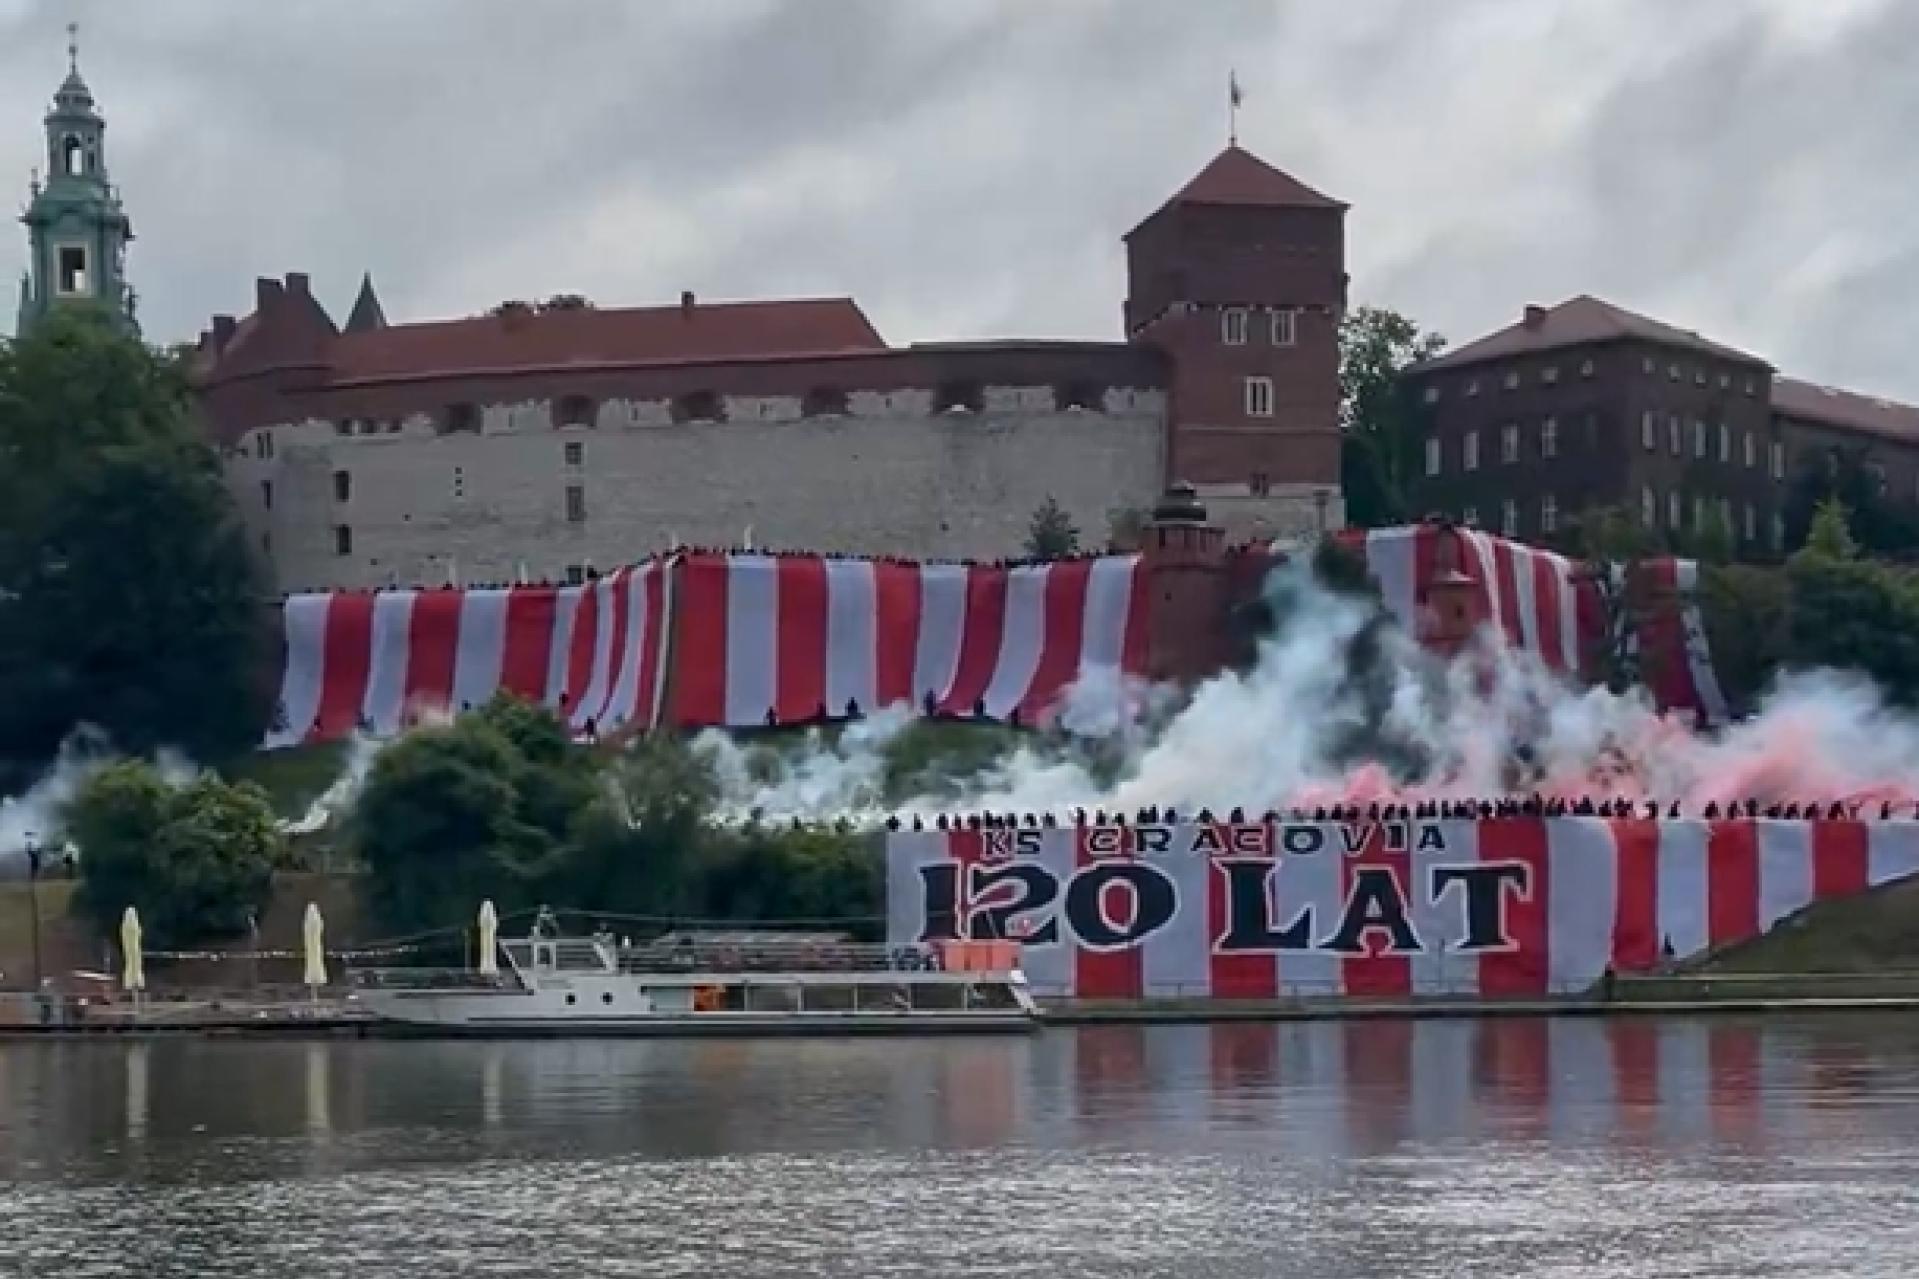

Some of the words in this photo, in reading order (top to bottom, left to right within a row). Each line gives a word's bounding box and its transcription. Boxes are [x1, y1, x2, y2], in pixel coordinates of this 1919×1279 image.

[984, 829, 1042, 855] KS
[1087, 825, 1446, 854] CRACOVIA
[918, 859, 1180, 951] 120
[1213, 857, 1533, 955] LAT
